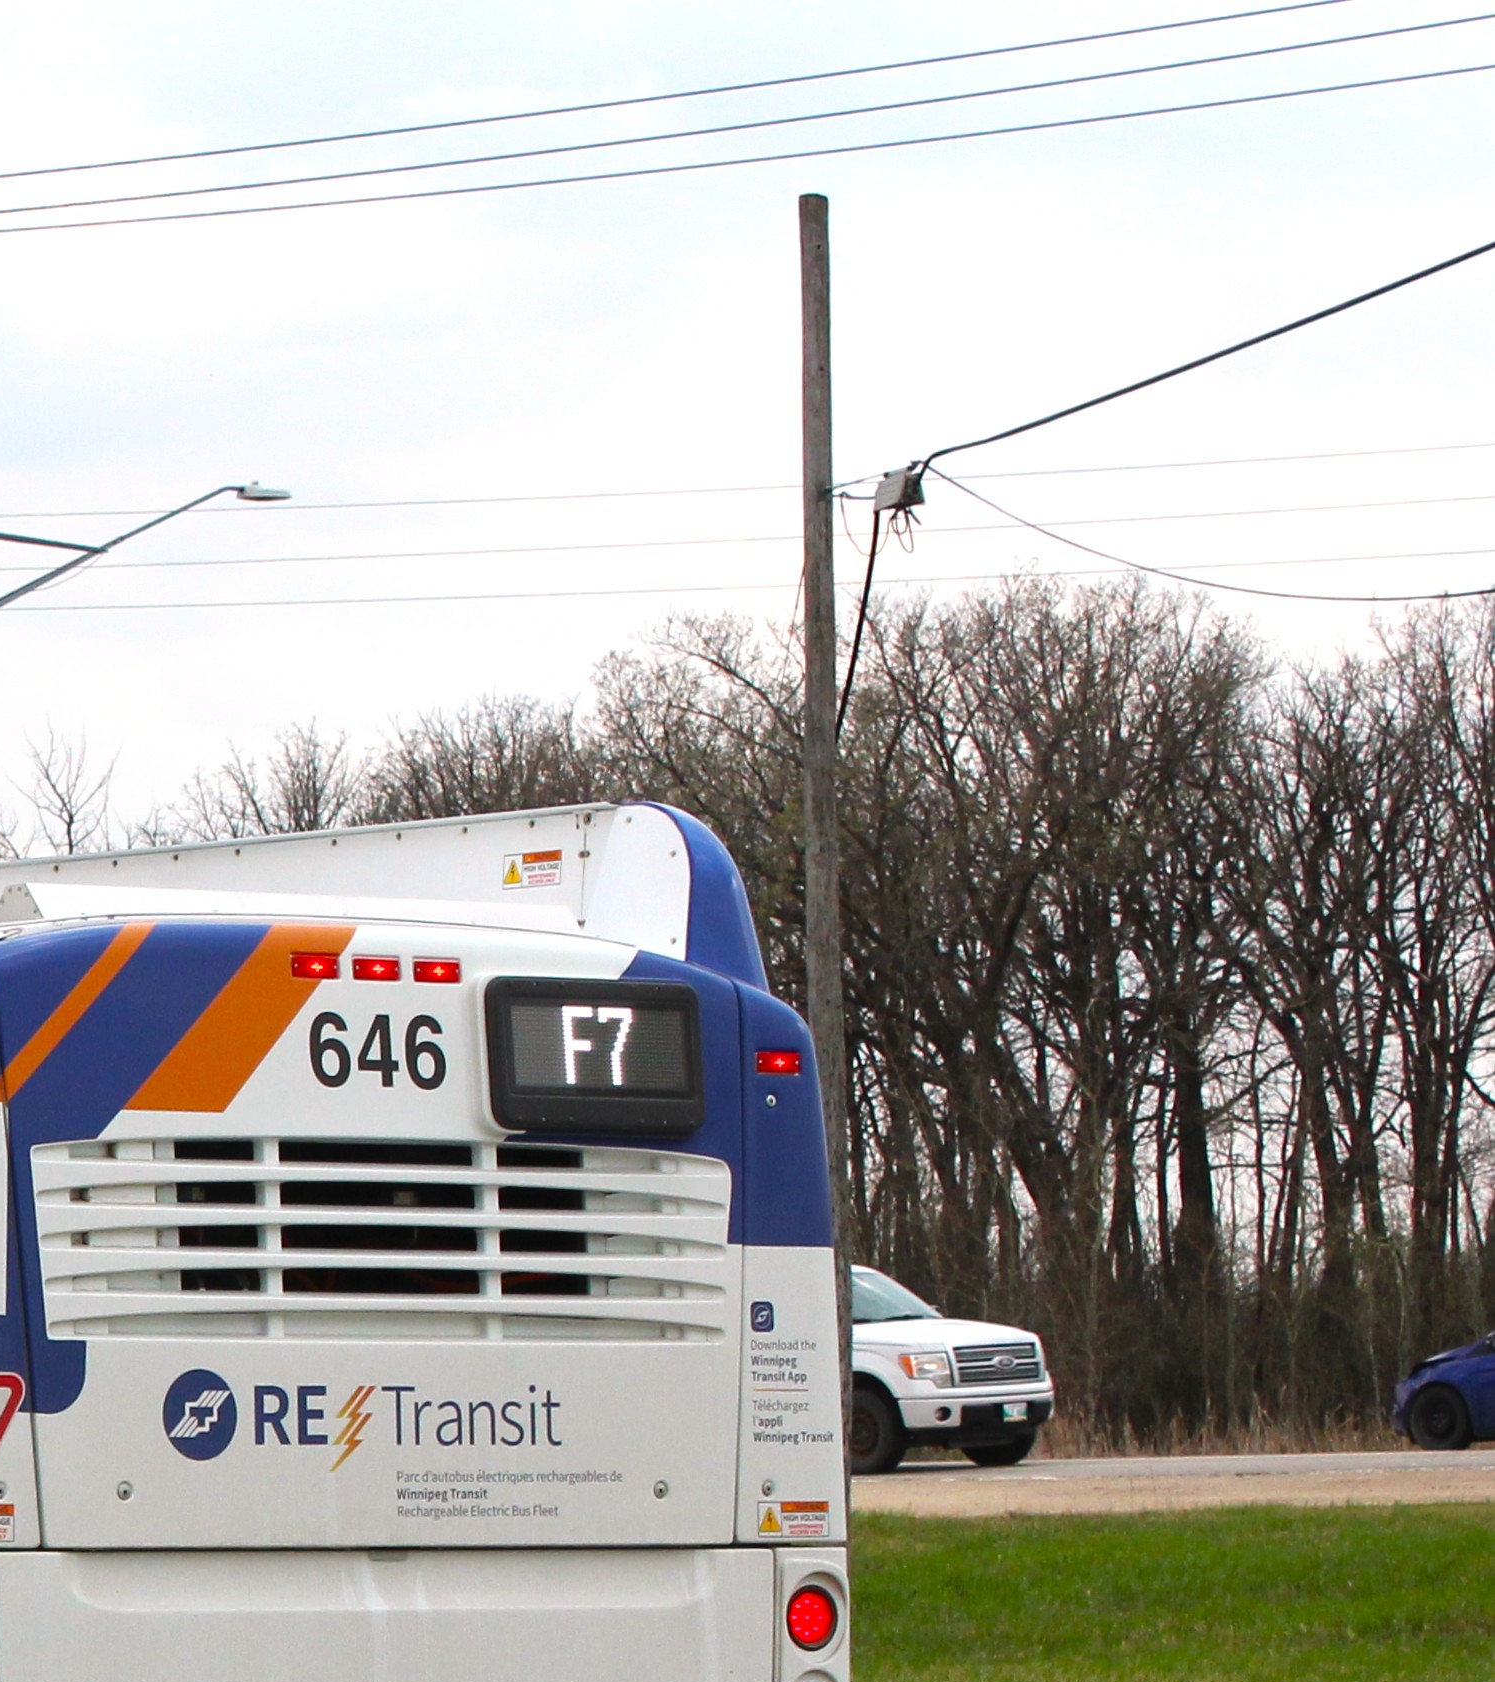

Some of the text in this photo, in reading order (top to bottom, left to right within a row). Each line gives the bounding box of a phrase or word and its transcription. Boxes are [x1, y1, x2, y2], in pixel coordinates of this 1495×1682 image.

[310, 1011, 446, 1090] 646
[561, 1005, 633, 1085] F7
[751, 1339, 817, 1351] Download the
[751, 1355, 797, 1369] Winnipeg
[752, 1371, 807, 1384] Transit App
[753, 1399, 809, 1414] Téléchargez
[254, 1384, 562, 1446] RE Transit
[753, 1415, 783, 1429] l'appli
[753, 1431, 834, 1445] Winnipeg Transit
[396, 1469, 623, 1485] Parc d'autobus électriques rechargeables de
[396, 1488, 487, 1503] Winnipeg Transit
[397, 1504, 559, 1520] Rechargeable Electric Bus Fleet
